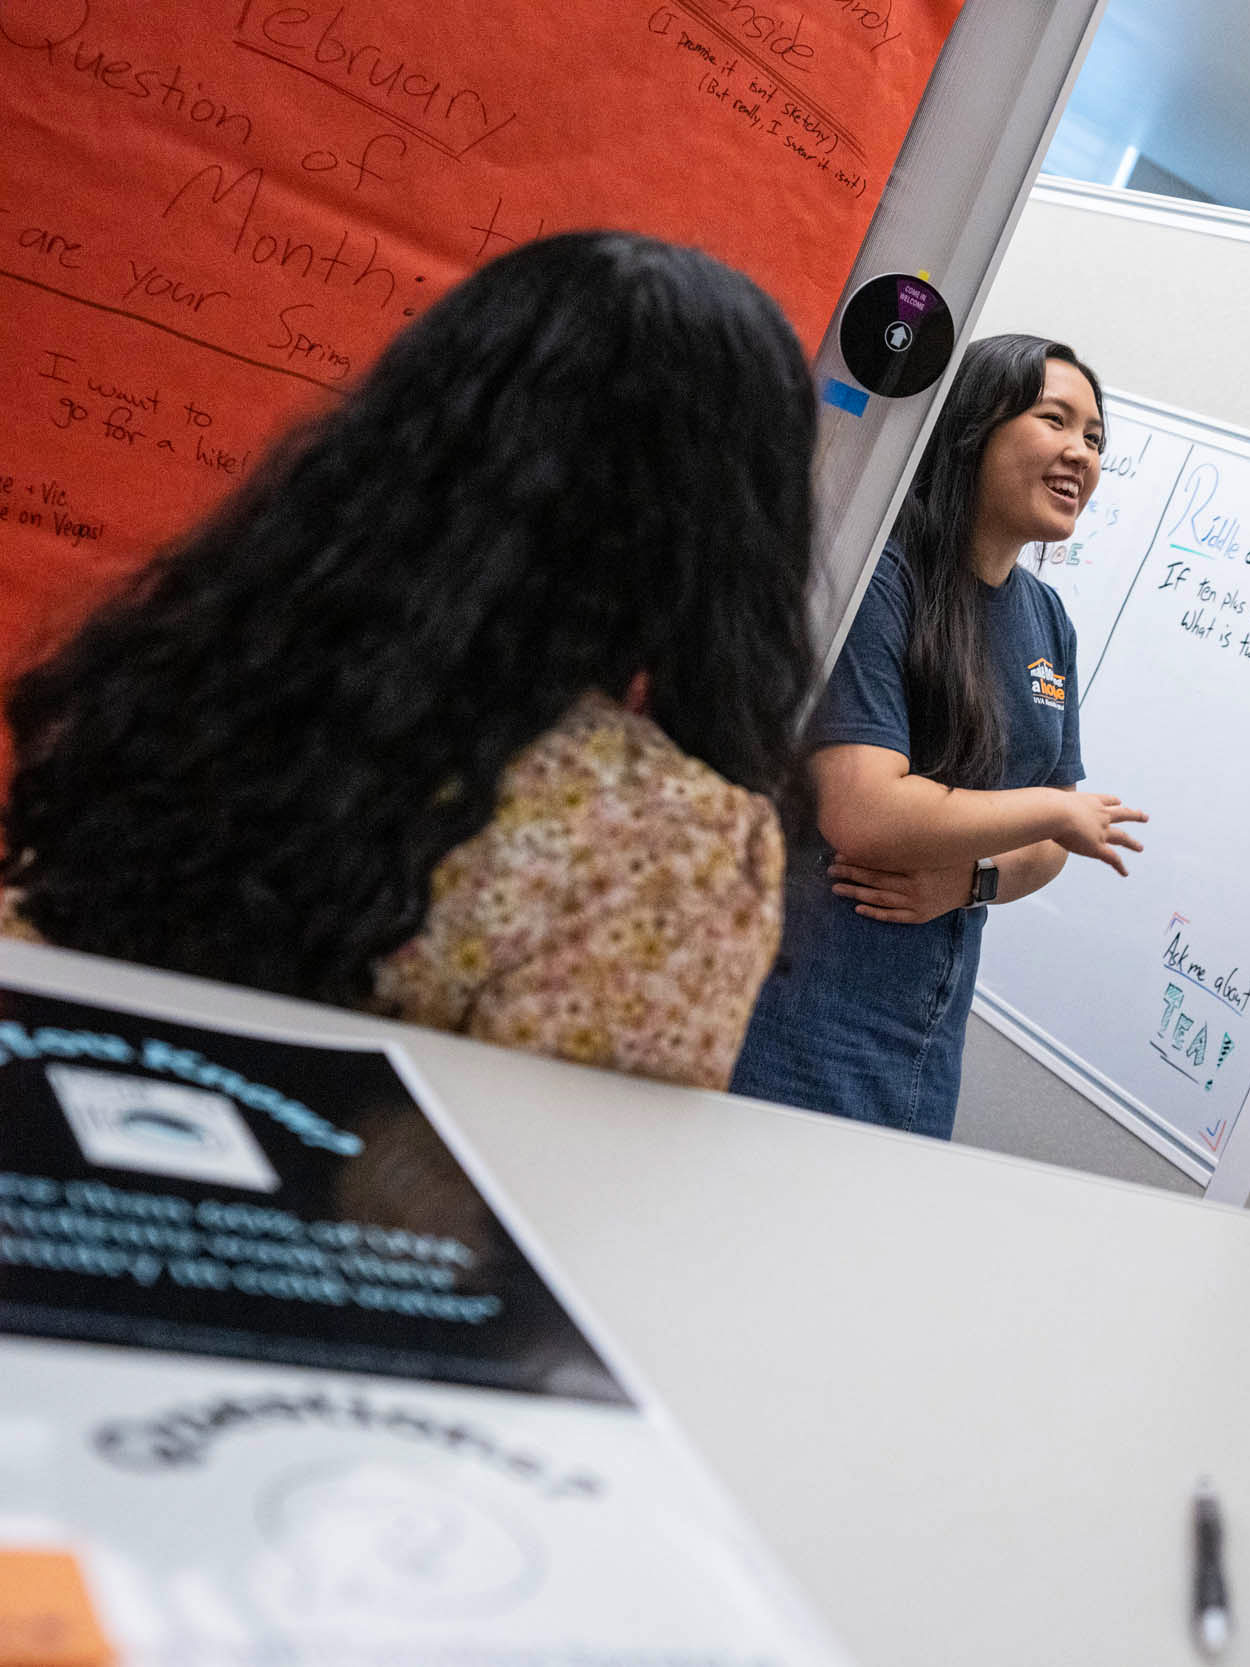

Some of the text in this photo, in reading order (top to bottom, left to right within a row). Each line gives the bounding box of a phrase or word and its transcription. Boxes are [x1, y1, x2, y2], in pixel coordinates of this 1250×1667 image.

[766, 119, 783, 136] I
[301, 134, 406, 191] of
[18, 228, 82, 269] are
[122, 260, 232, 312] your
[39, 350, 213, 428] I want to
[51, 398, 88, 429] go
[102, 406, 147, 446] for
[156, 439, 175, 454] a
[19, 510, 42, 529] on
[1167, 463, 1241, 560] Riddle
[1157, 561, 1191, 590] If
[1197, 577, 1217, 602] ten
[1220, 590, 1246, 615] plus
[1219, 623, 1233, 649] is
[1163, 931, 1190, 972] Ask
[1188, 961, 1206, 983] me
